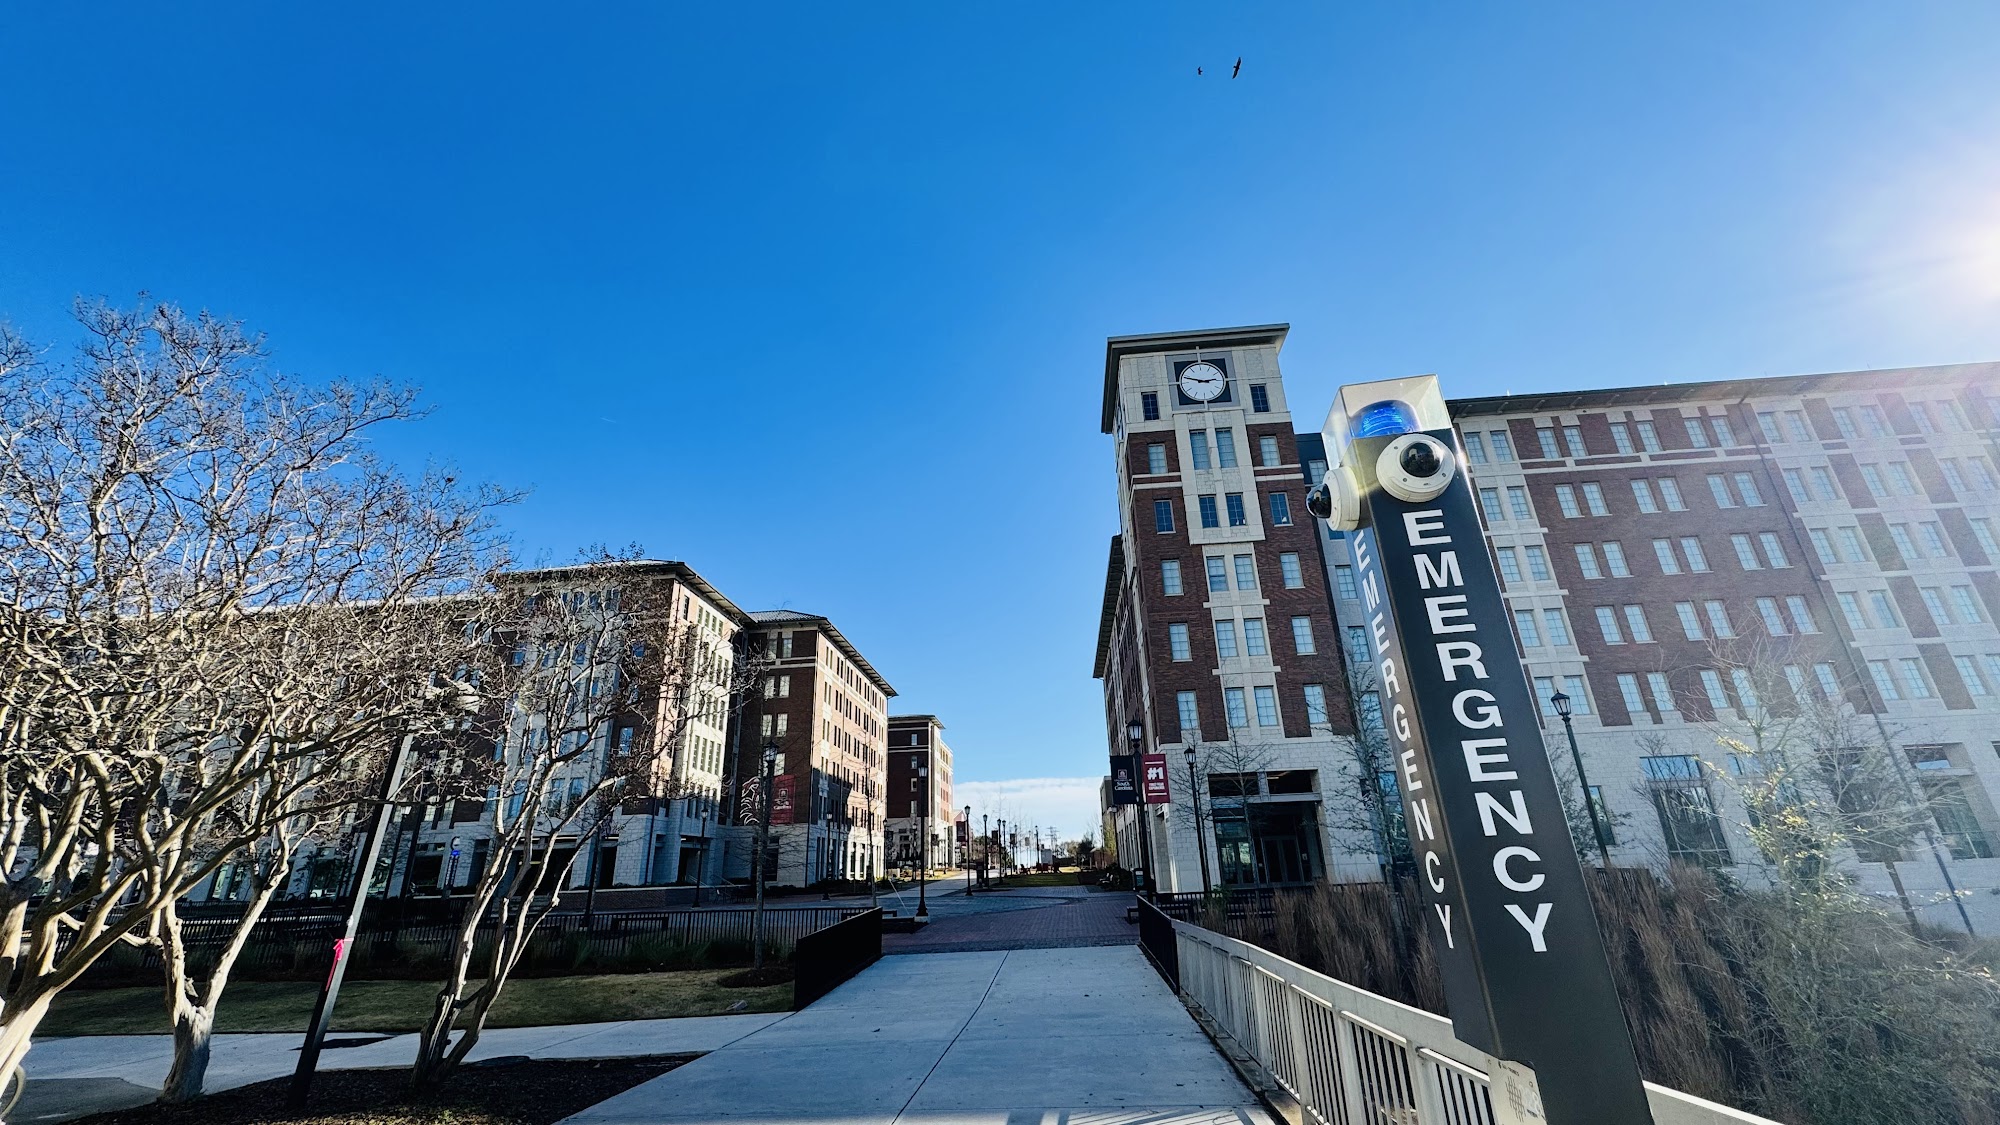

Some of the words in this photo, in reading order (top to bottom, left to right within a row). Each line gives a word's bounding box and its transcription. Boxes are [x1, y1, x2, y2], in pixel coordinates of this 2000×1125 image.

[1147, 767, 1164, 780] #1
[1353, 530, 1454, 949] EMERGENCY
[1402, 509, 1553, 952] EMERGENCY
